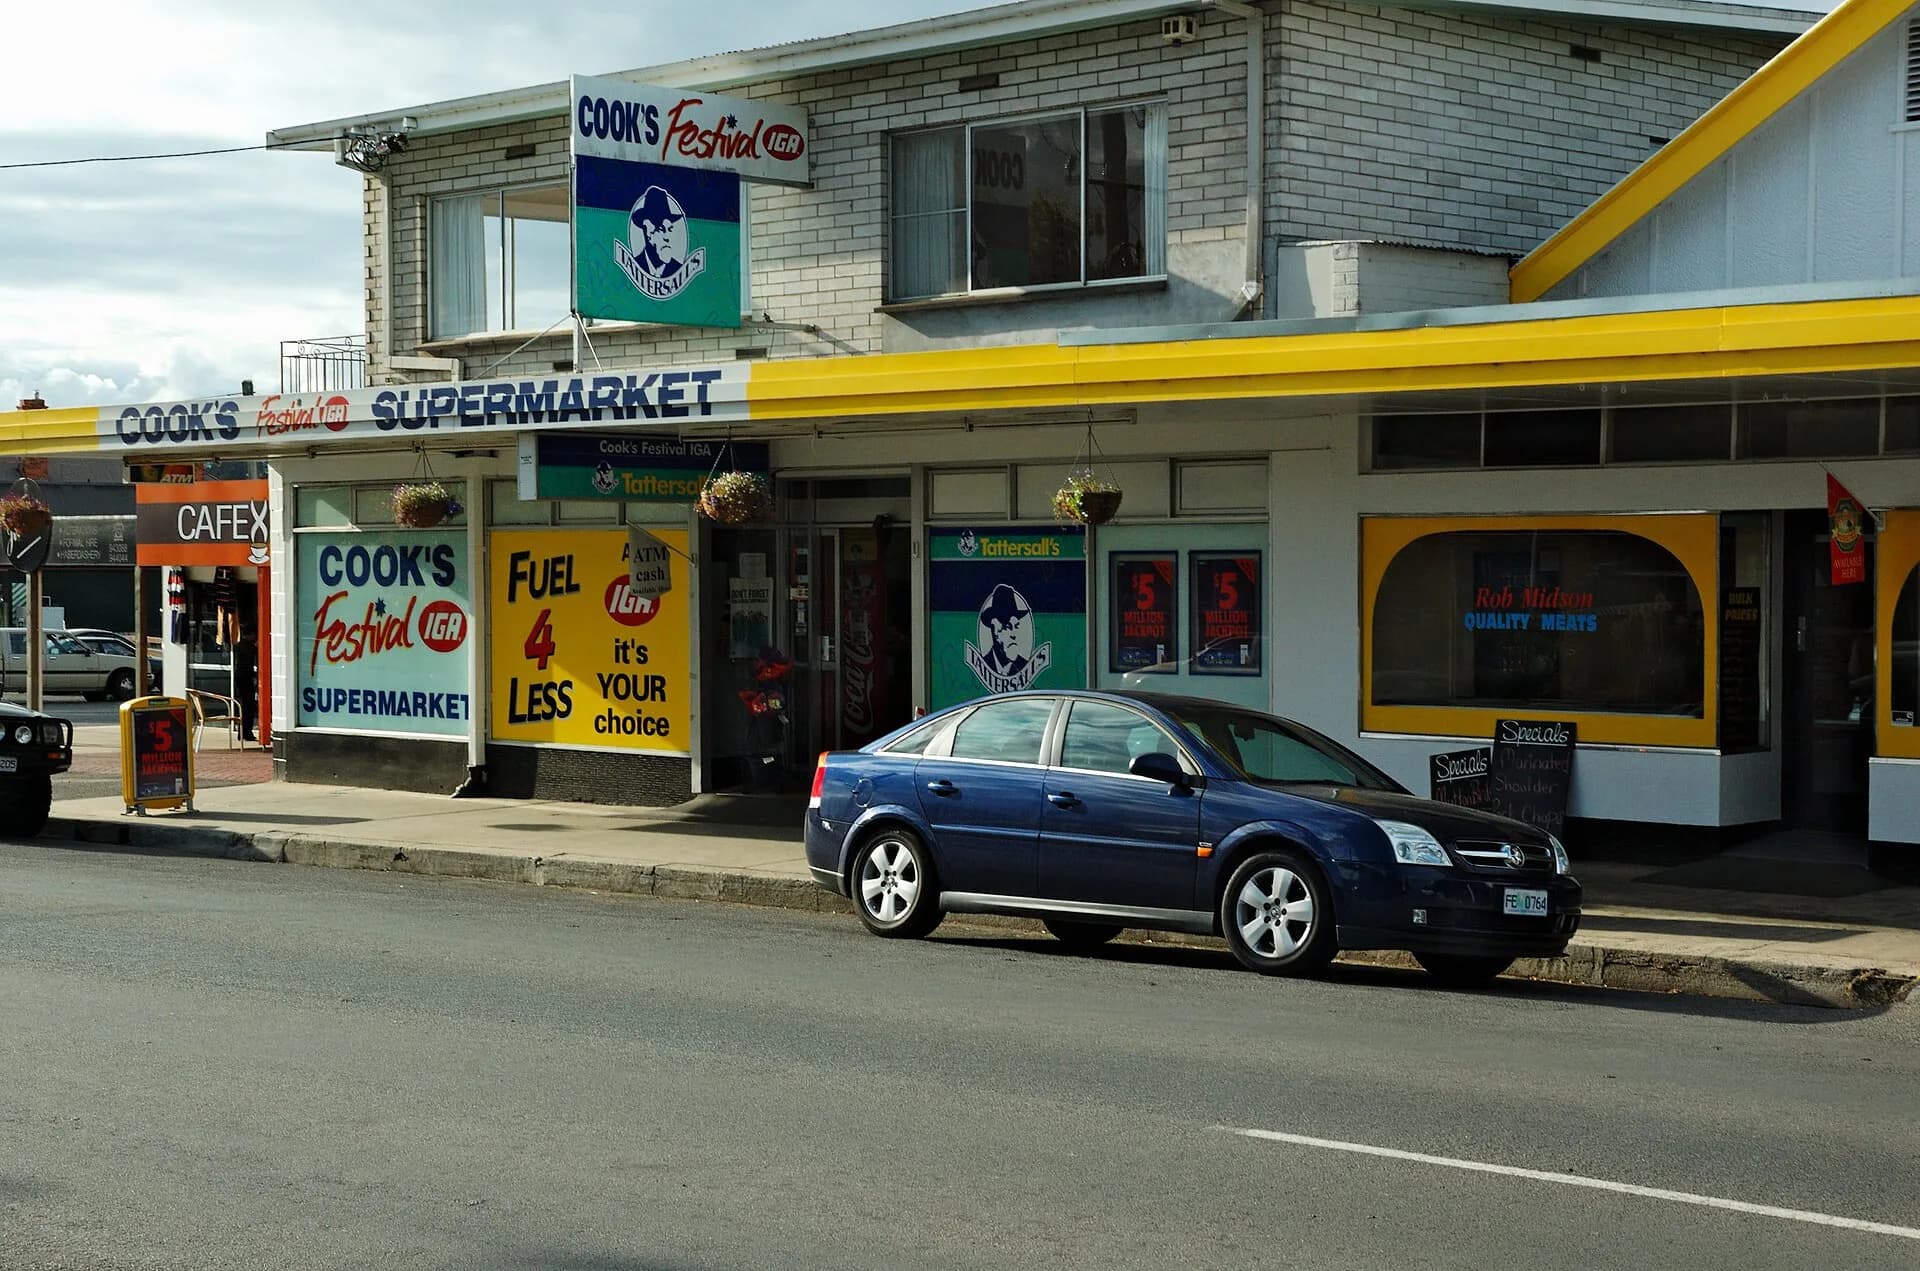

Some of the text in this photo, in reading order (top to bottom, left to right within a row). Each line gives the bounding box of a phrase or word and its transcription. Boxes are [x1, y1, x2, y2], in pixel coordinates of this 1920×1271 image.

[578, 95, 801, 162] COOK'S Festival IGA
[371, 370, 722, 431] SUPERMARKET
[116, 394, 346, 445] COOK'S Festival IGA
[599, 439, 712, 456] Cook's Festival IGA
[160, 473, 193, 484] ATM
[177, 499, 269, 543] CAFEX
[633, 545, 667, 563] ATM
[980, 537, 1060, 556] Tattersall's
[319, 544, 456, 587] COOK'S
[508, 550, 580, 603] FUEL
[636, 566, 665, 582] cash
[1475, 584, 1594, 609] Rob Midson
[424, 612, 463, 641] IGA
[1124, 610, 1165, 624] MILLION
[1204, 610, 1249, 623] MILLION
[1463, 611, 1598, 632] QUALITY MEATS
[311, 590, 417, 678] Festival
[524, 608, 556, 671] 4
[614, 638, 648, 665] it's
[508, 677, 573, 724] LESS
[597, 672, 666, 702] YOUR
[302, 686, 469, 720] SUPERMARKET
[594, 708, 670, 737] choice
[1500, 720, 1570, 747] Specials
[1435, 749, 1488, 784] Specials
[1505, 894, 1546, 910] FE 0764
